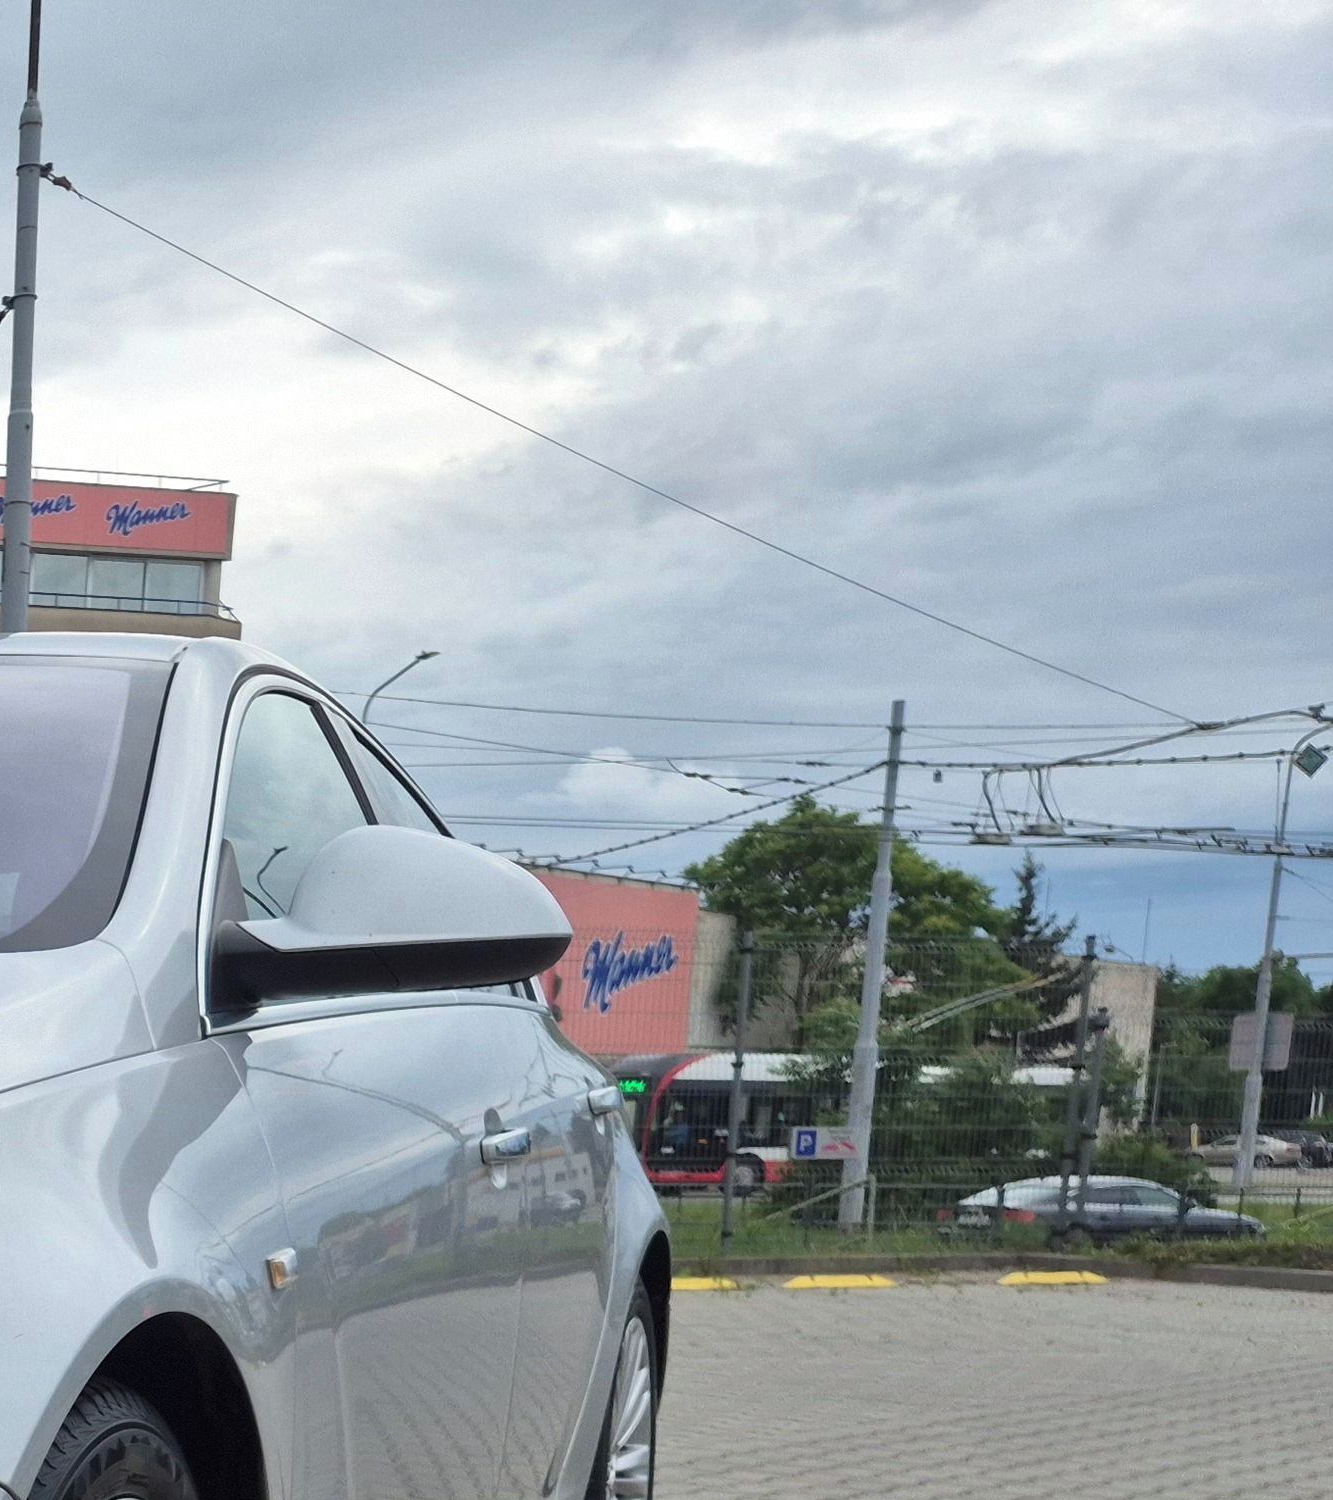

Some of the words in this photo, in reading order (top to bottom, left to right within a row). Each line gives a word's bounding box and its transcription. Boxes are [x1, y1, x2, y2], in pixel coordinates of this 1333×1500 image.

[106, 501, 190, 536] Manner
[582, 930, 678, 1017] Manner
[800, 1133, 813, 1152] P
